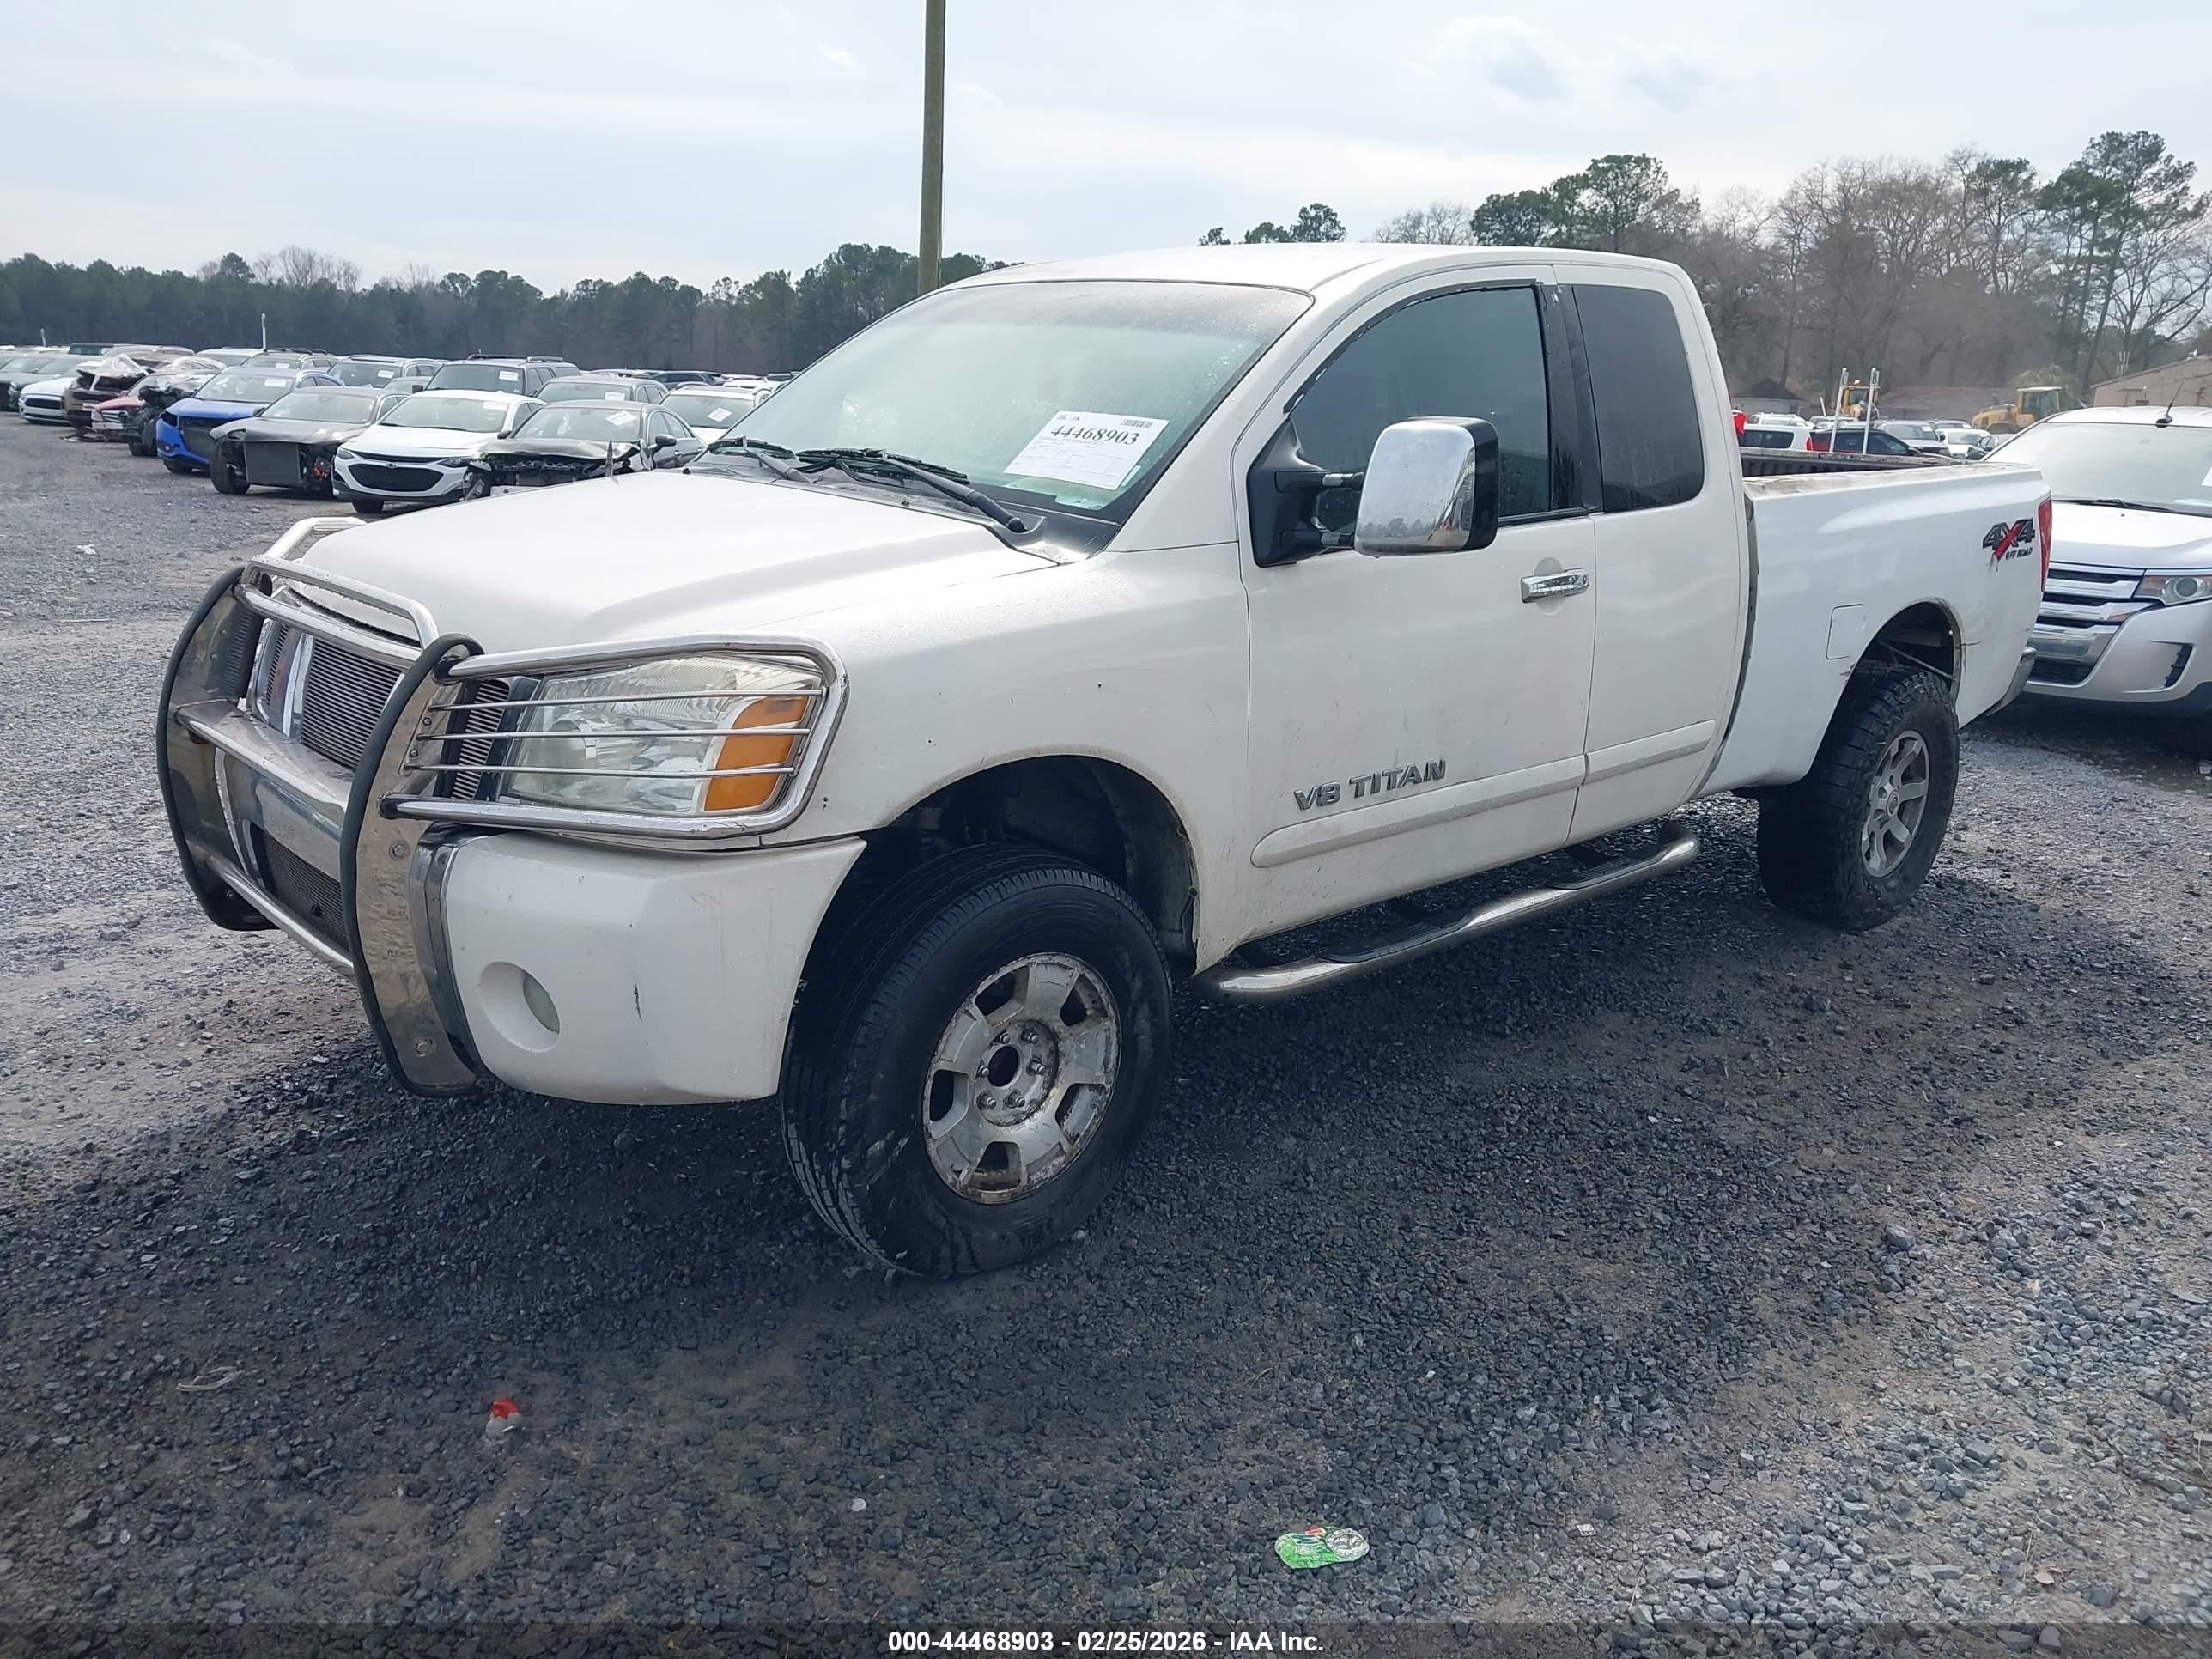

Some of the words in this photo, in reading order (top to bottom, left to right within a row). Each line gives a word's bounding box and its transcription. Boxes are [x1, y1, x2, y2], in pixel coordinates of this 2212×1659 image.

[1050, 425, 1140, 445] 44468903
[2005, 550, 2017, 560] OFF
[2016, 547, 2033, 558] ROAD
[1293, 782, 1341, 811] V8
[1349, 759, 1447, 799] TITAN
